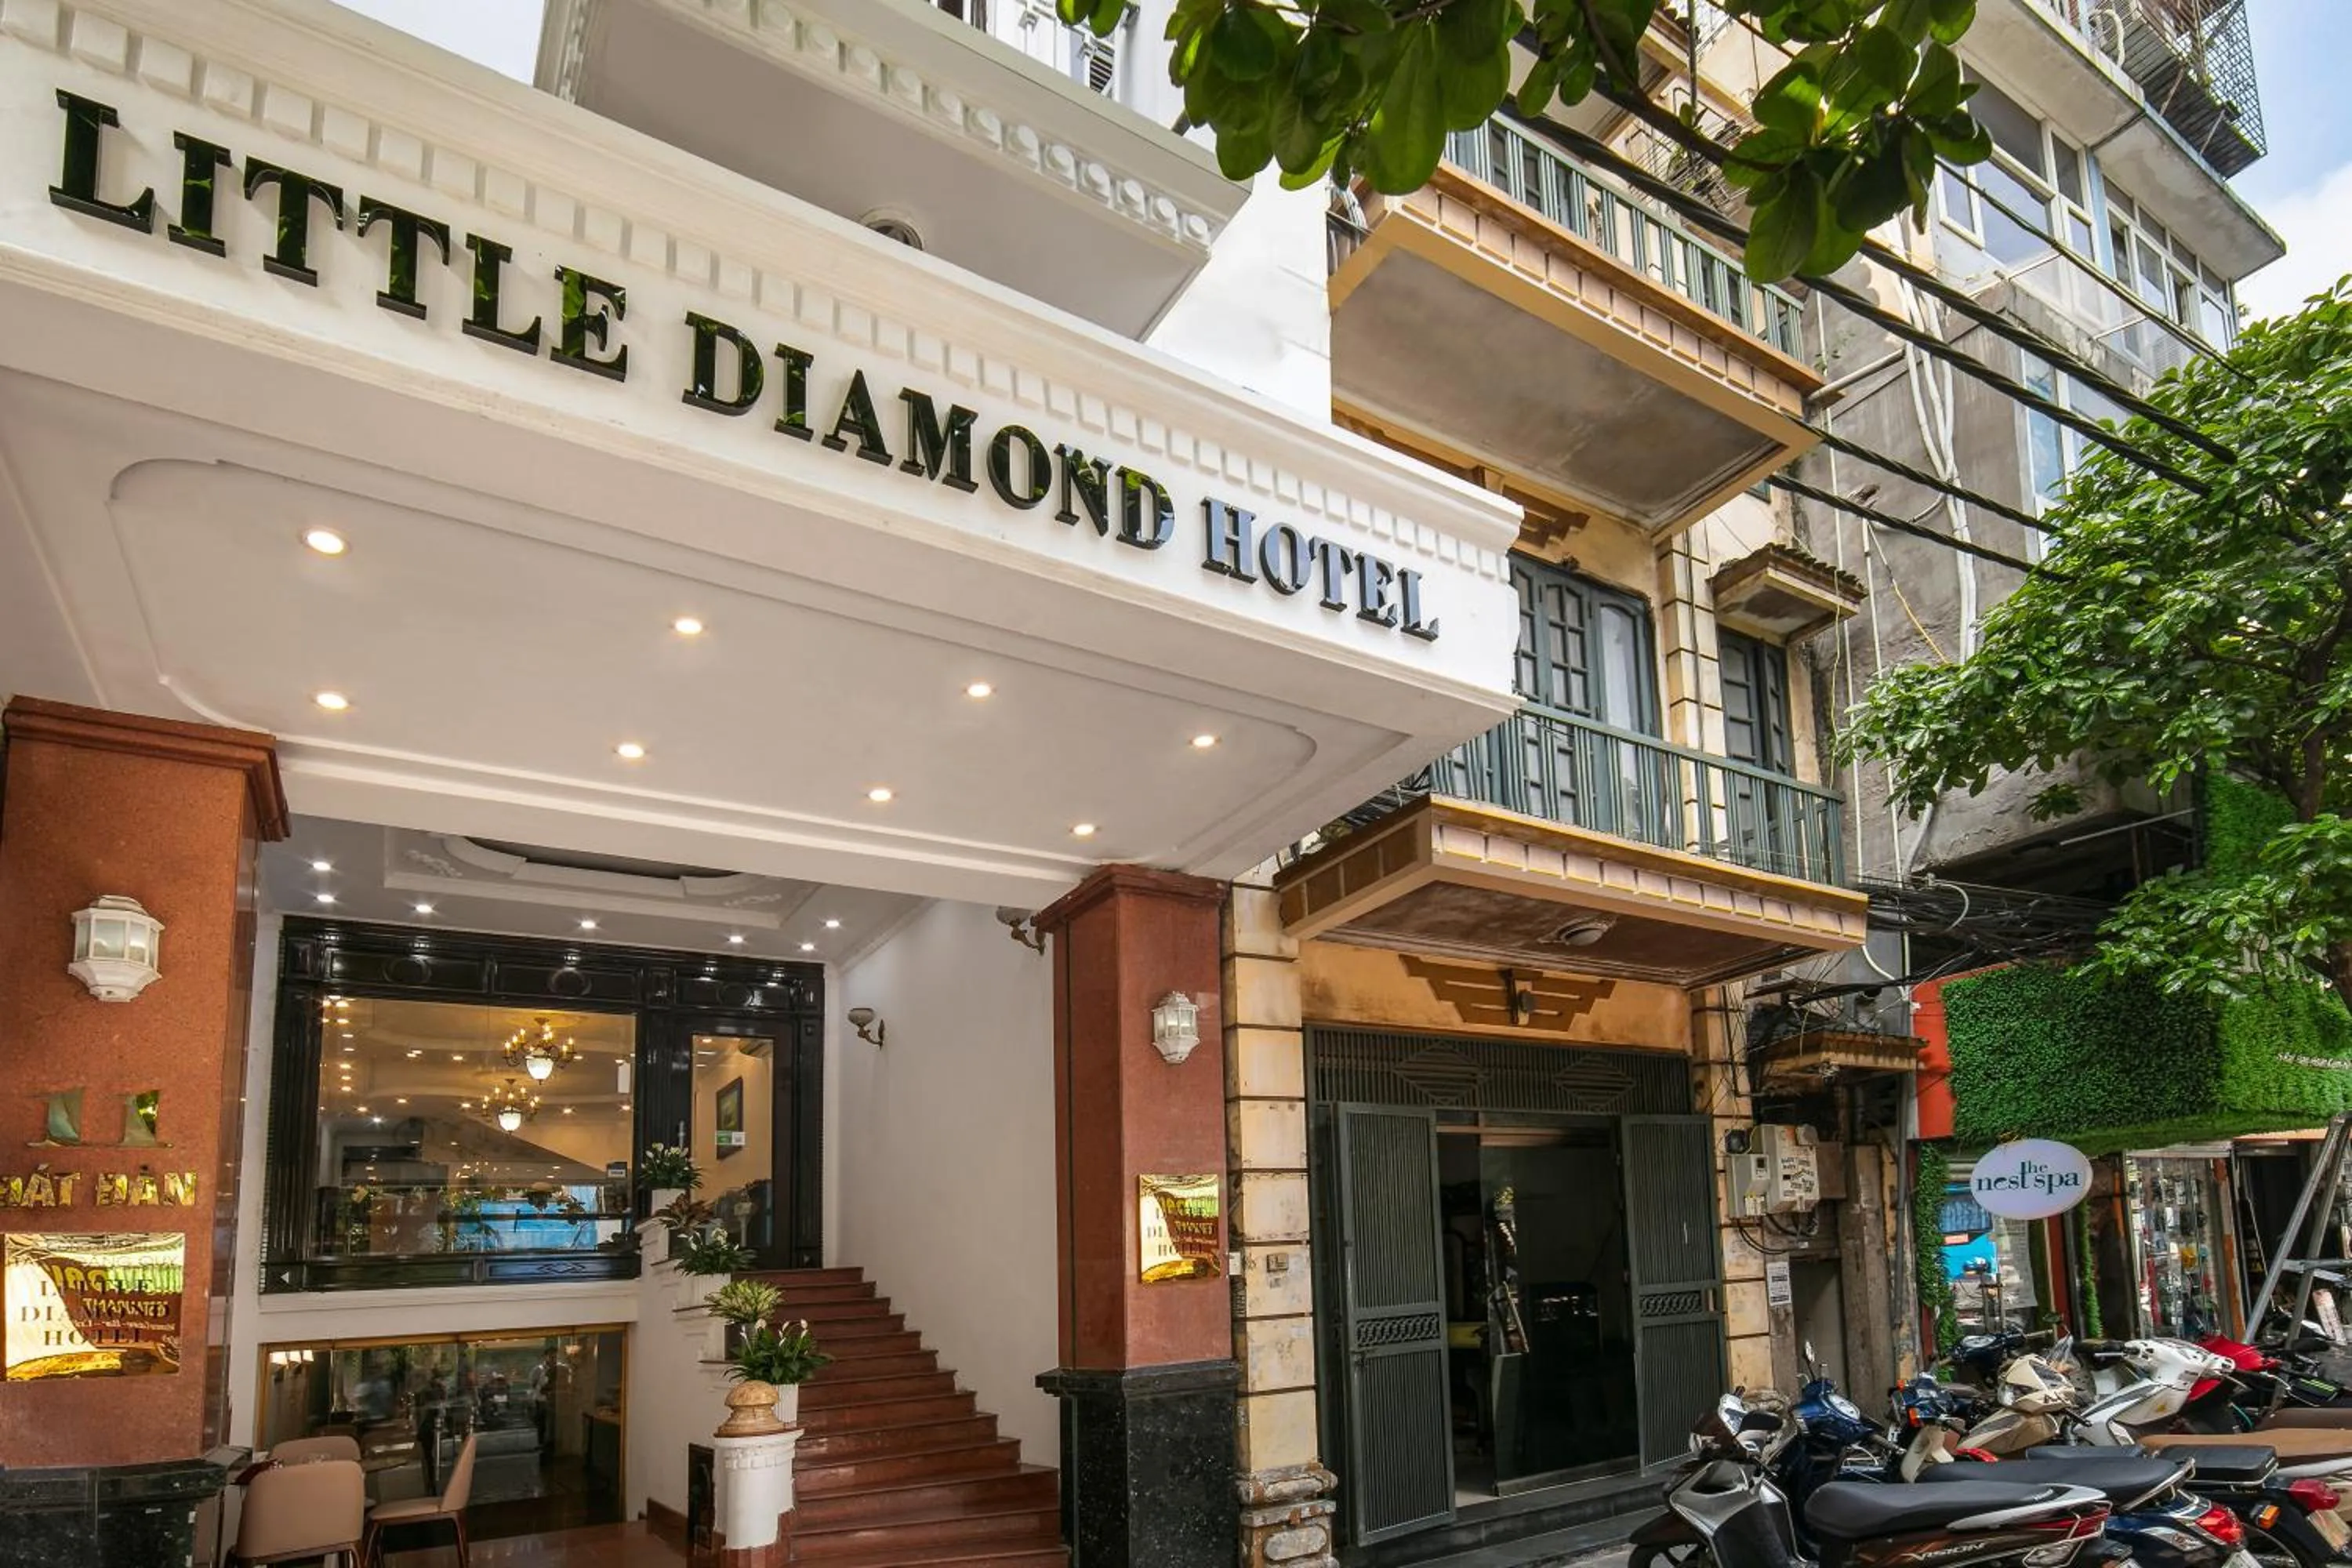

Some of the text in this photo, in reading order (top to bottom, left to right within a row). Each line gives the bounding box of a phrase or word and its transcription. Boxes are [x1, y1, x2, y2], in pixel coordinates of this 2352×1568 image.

[49, 88, 1440, 642] LITTLE DIAMOND HOTEL
[1976, 1167, 2081, 1196] nest spa
[2020, 1160, 2049, 1174] the
